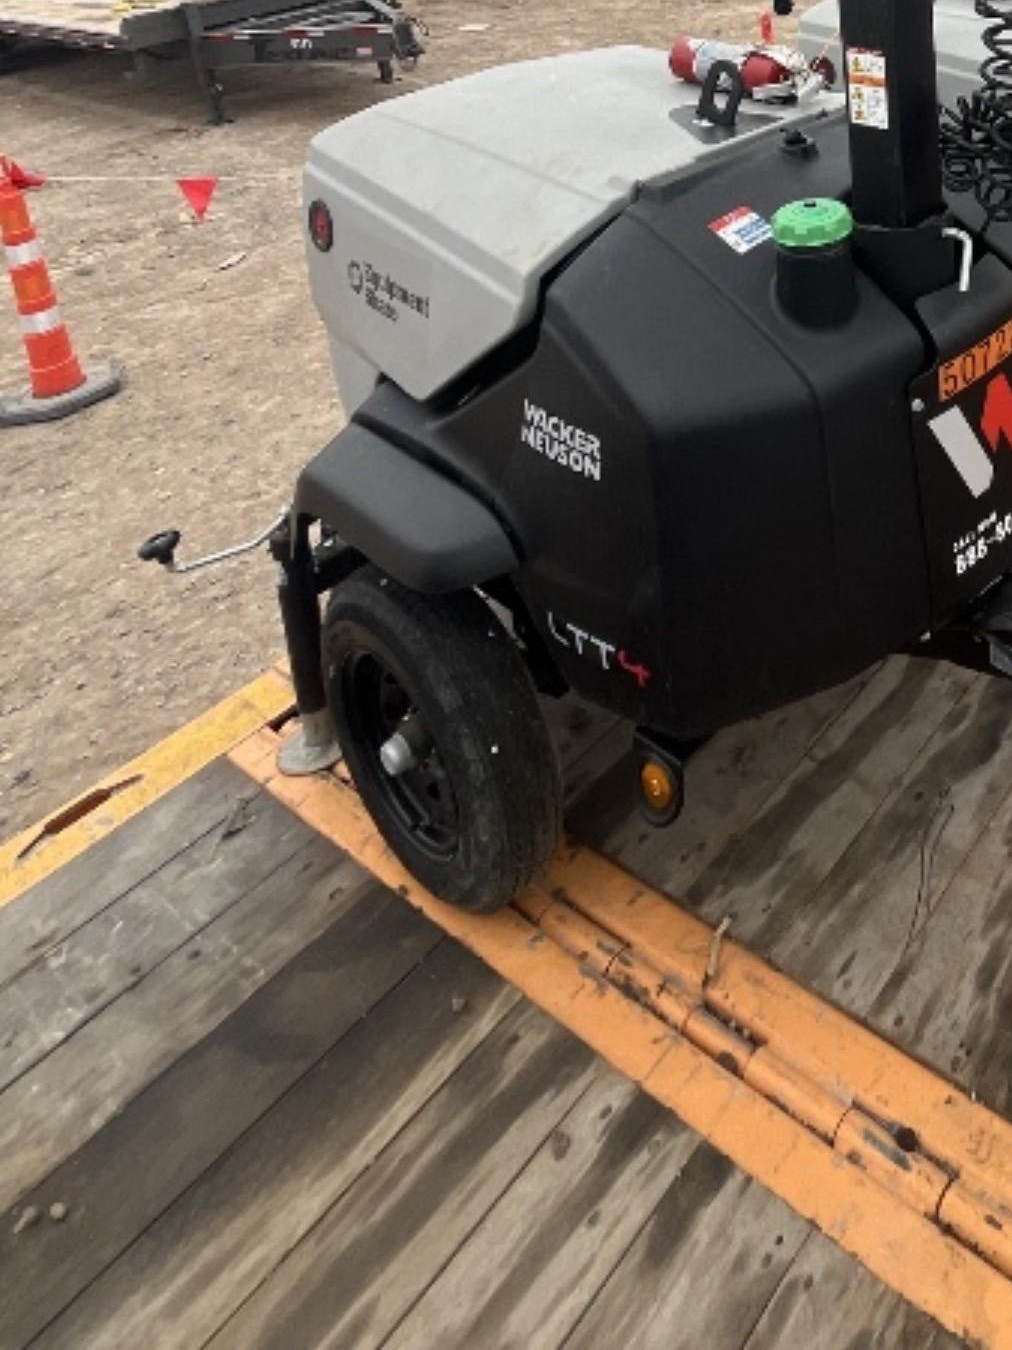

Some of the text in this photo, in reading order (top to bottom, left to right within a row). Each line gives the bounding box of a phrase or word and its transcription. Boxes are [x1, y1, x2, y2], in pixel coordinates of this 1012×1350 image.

[520, 424, 602, 482] NEUSON
[522, 397, 602, 461] WACKER
[547, 610, 652, 688] LTT4
